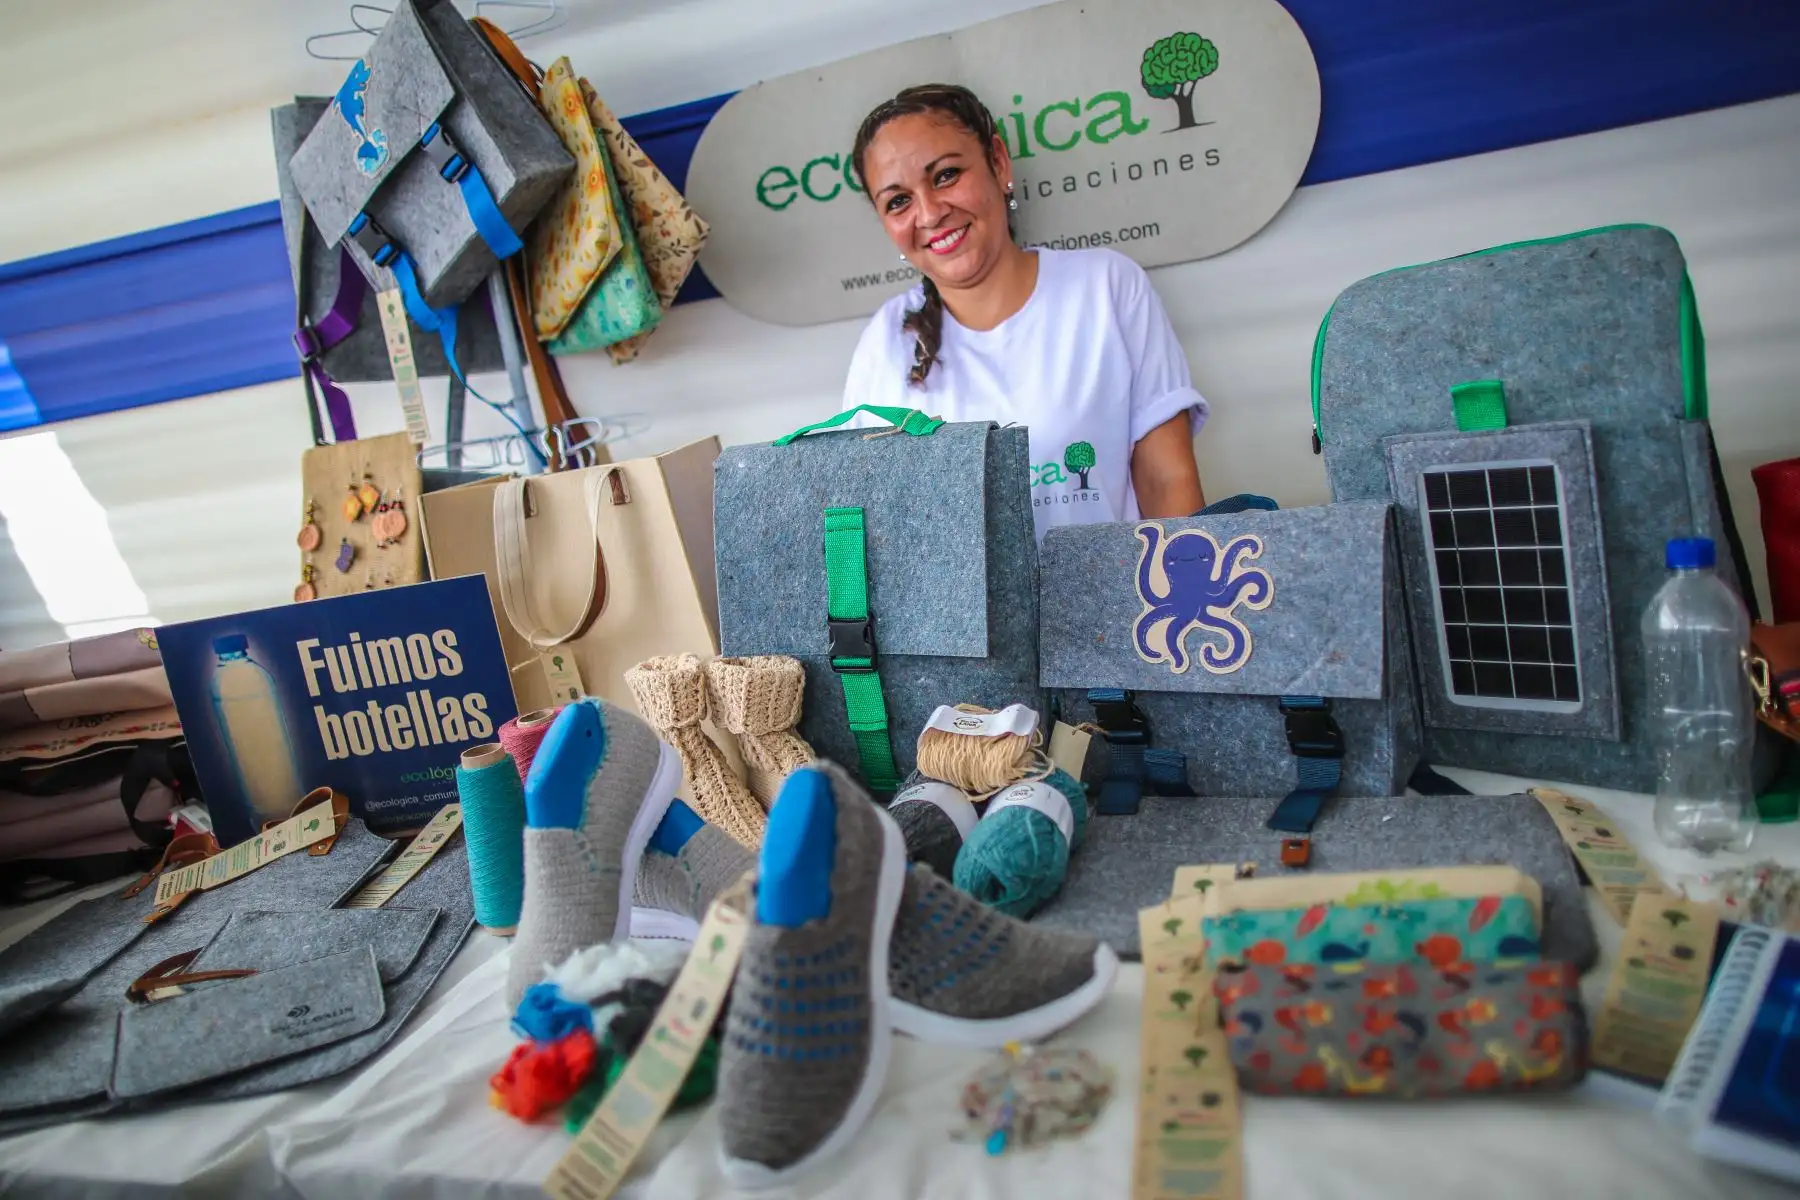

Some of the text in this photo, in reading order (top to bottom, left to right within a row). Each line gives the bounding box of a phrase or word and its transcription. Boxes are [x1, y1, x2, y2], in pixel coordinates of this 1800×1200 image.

[1034, 492, 1100, 507] aciones
[296, 628, 464, 697] Fuimos
[313, 689, 494, 761] botellas
